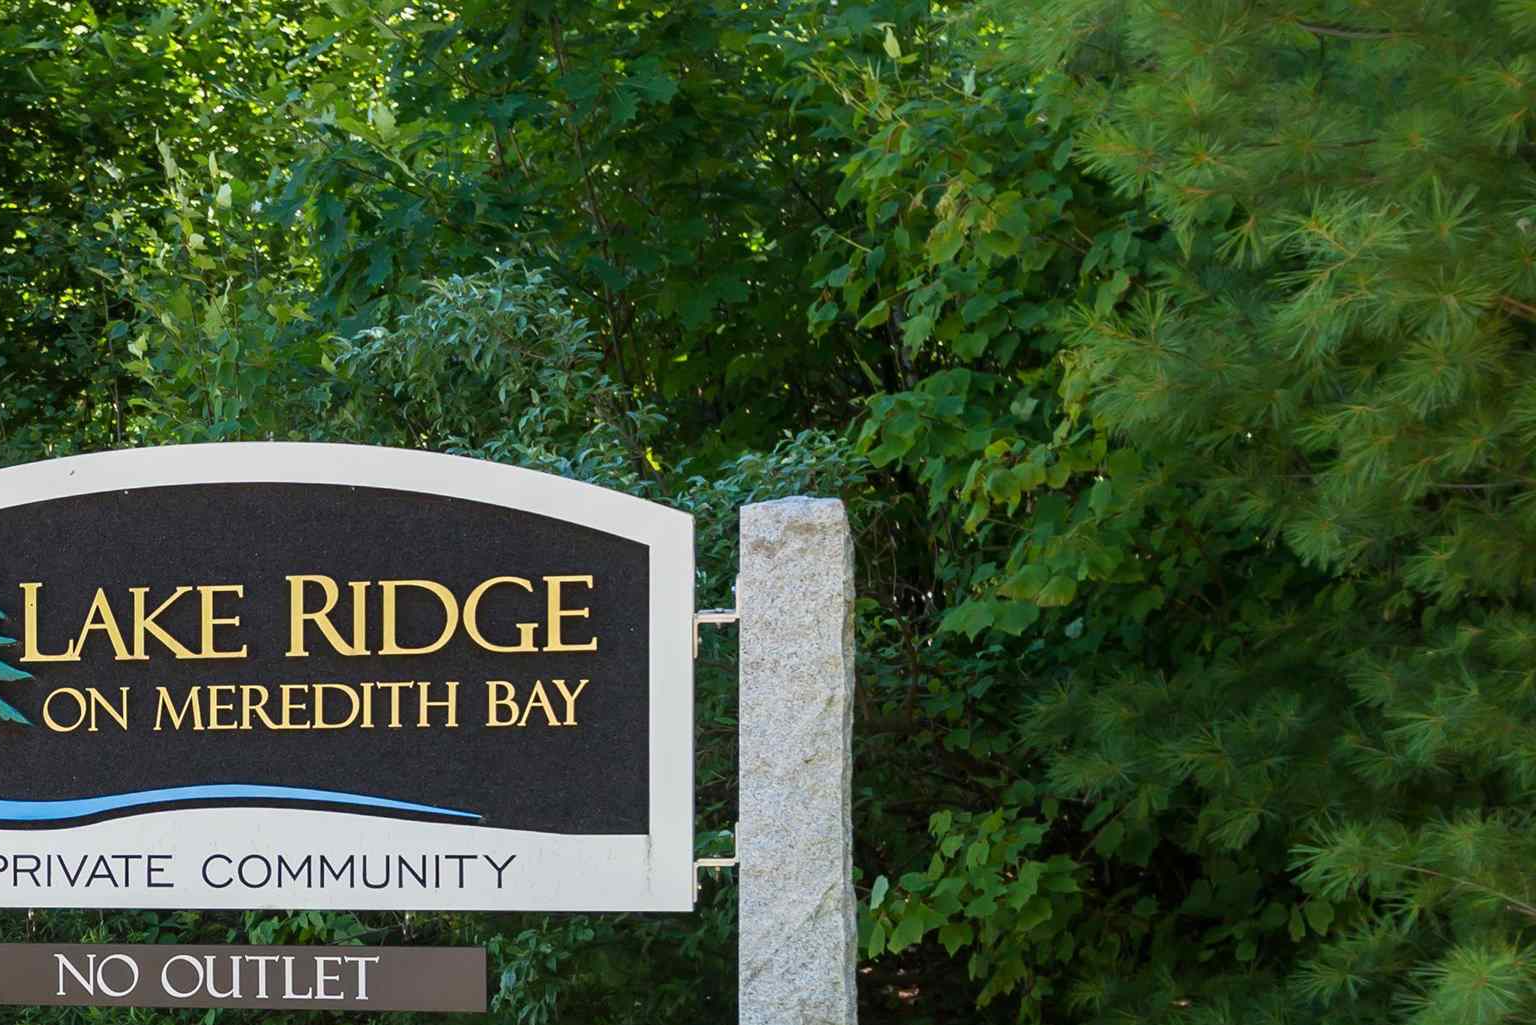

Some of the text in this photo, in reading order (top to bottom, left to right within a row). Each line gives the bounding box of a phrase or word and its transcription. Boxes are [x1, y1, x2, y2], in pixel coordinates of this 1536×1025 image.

[20, 575, 598, 663] LAKE RIDGE
[43, 680, 590, 732] ON MEREDITH BAY
[201, 854, 517, 889] COMMUNITY
[54, 953, 380, 1001] NO OUTLET
